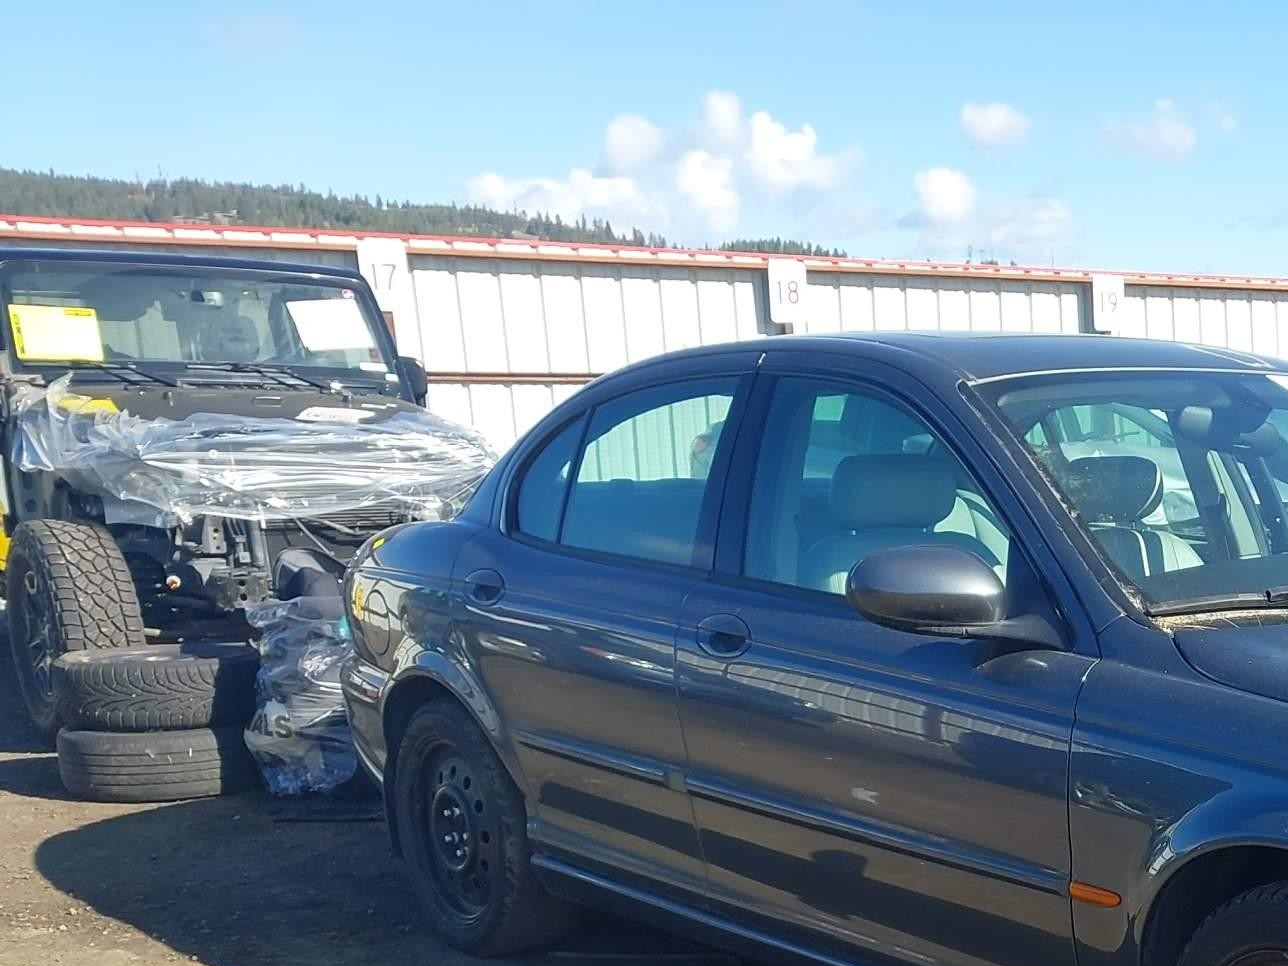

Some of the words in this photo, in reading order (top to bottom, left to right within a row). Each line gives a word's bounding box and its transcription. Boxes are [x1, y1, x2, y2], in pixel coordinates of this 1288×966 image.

[371, 263, 396, 290] 17
[777, 280, 799, 304] 18
[1100, 292, 1117, 312] 19
